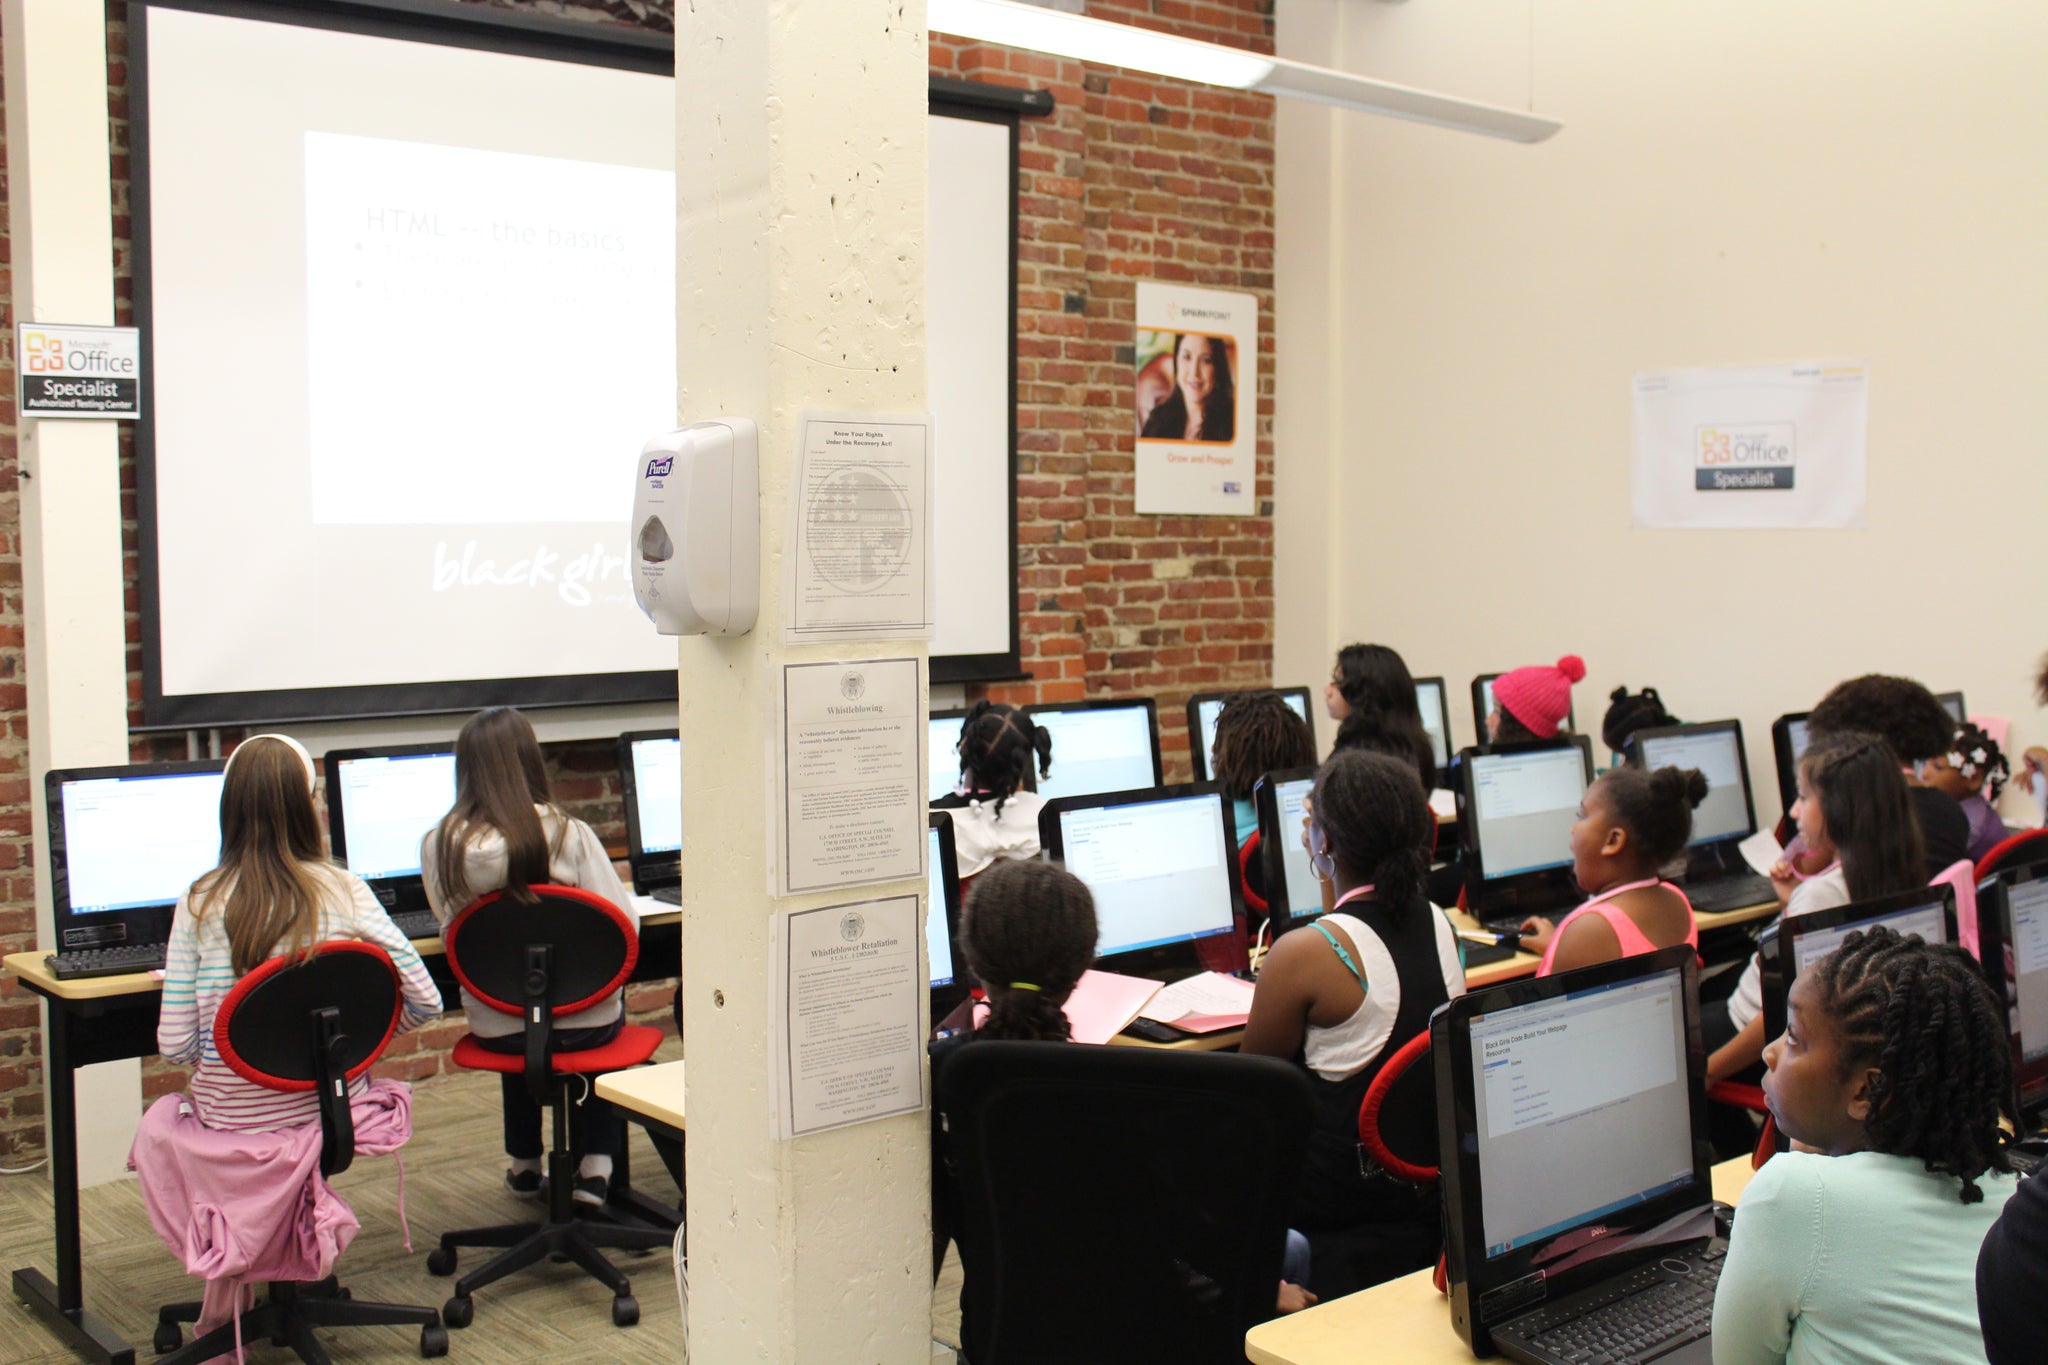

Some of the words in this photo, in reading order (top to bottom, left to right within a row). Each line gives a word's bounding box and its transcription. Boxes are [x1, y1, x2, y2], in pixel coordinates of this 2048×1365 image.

[367, 207, 447, 236] HTML
[492, 220, 536, 244] the
[548, 224, 624, 252] basics
[68, 350, 133, 373] Office
[44, 380, 118, 399] Specialist
[28, 398, 76, 408] Authorized
[76, 400, 104, 410] Testing
[105, 400, 132, 409] Center
[1734, 442, 1788, 462] Office
[1713, 470, 1775, 490] Specialist
[827, 704, 883, 714] Whistleblowing
[811, 945, 860, 958] Whistleblower
[861, 939, 898, 950] Retaliation
[1511, 1035, 1522, 1043] Code
[1486, 1047, 1510, 1058] Resources
